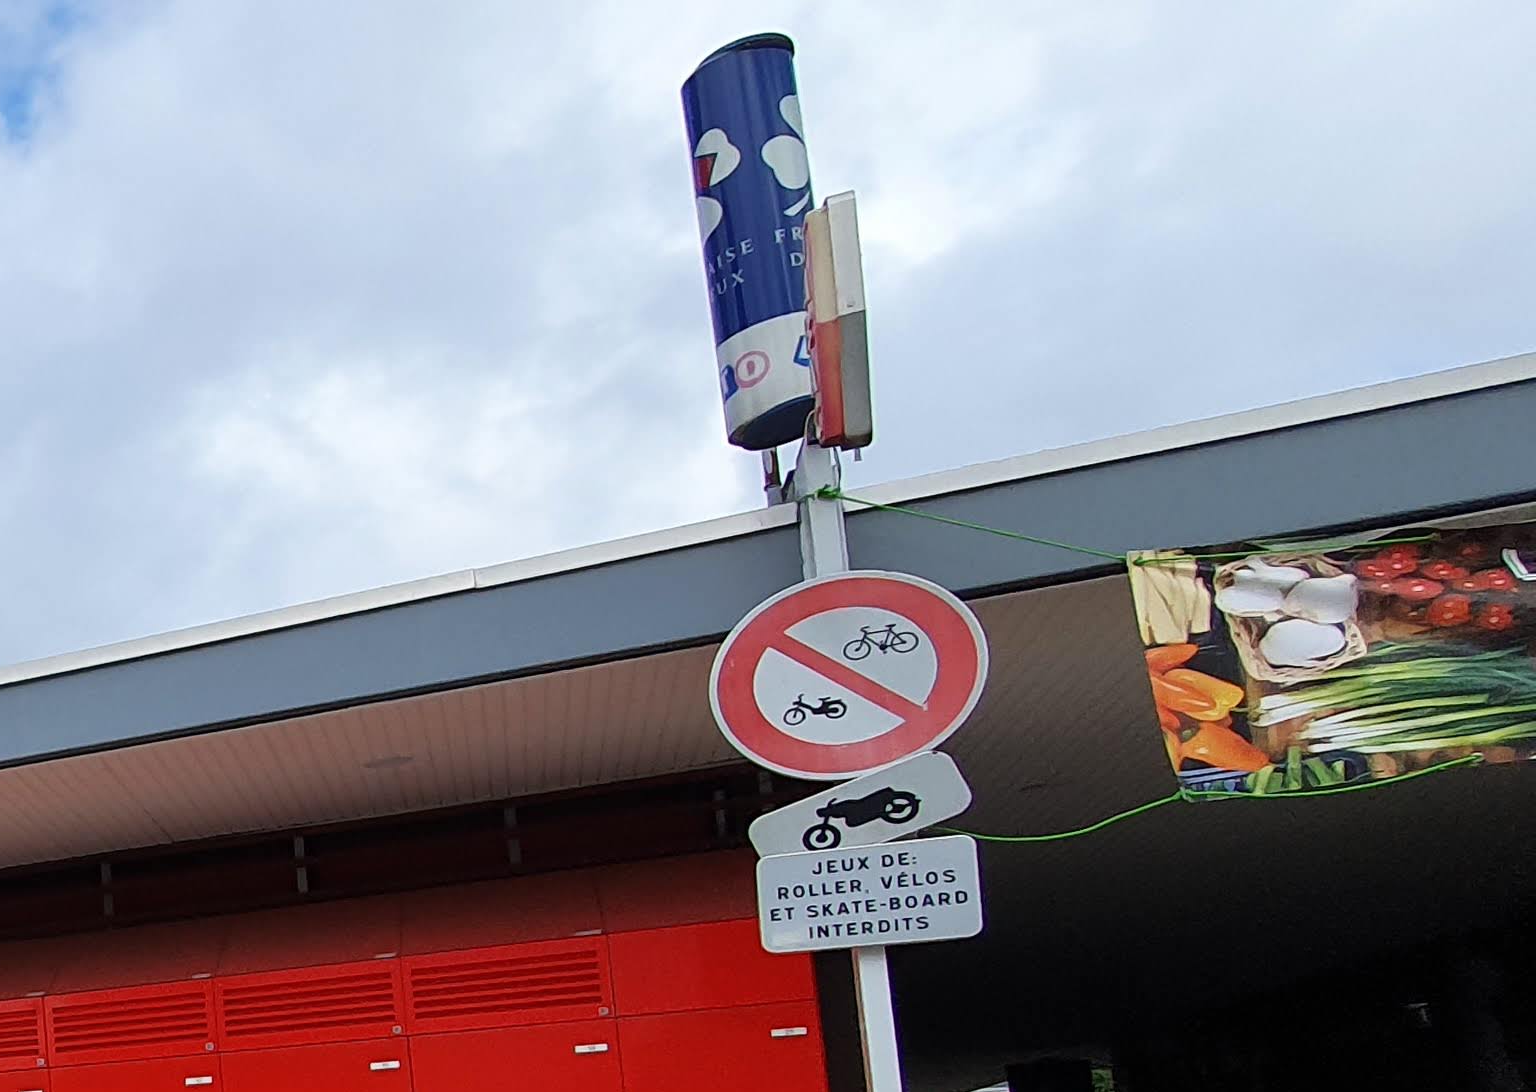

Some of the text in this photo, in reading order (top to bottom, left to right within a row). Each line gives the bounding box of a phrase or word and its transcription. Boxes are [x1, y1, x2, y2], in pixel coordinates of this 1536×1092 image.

[812, 852, 918, 875] JEUX DE:
[777, 869, 957, 900] ROLLER, VÉLOS
[770, 890, 969, 921] ET SKATE-BOARD
[809, 916, 929, 939] INTERDITS
